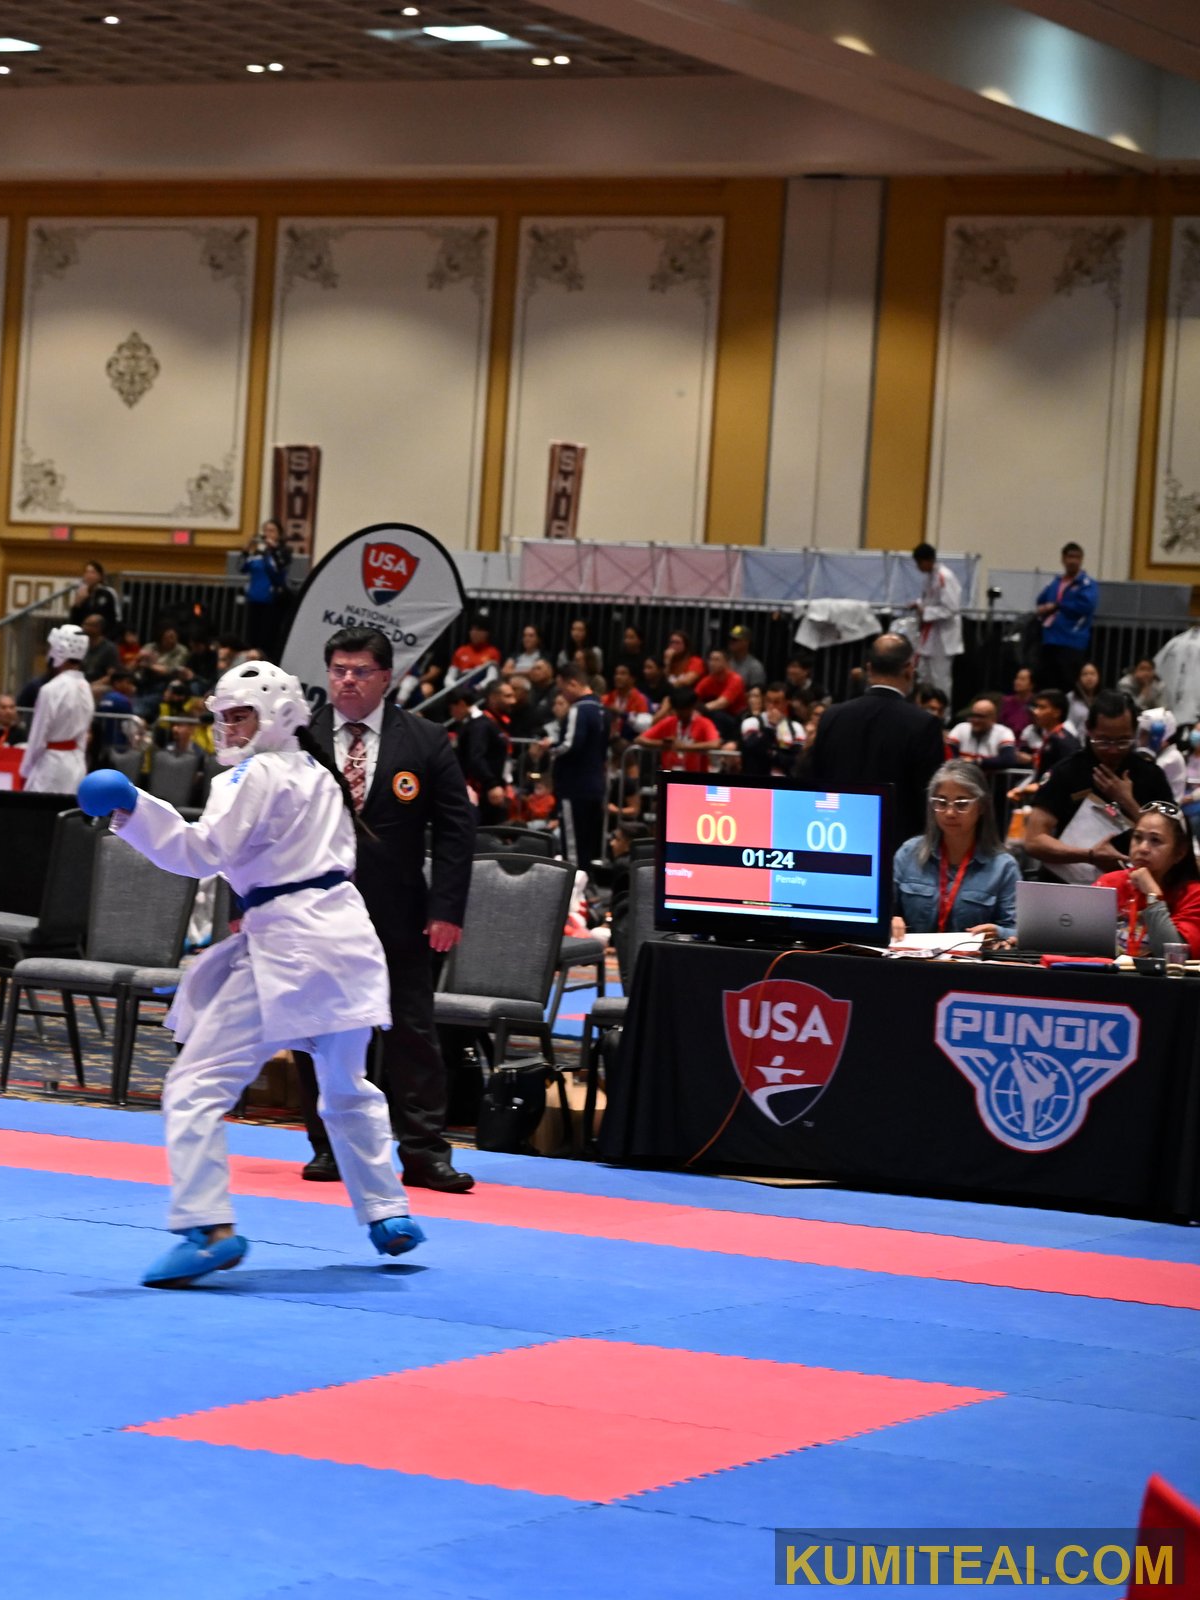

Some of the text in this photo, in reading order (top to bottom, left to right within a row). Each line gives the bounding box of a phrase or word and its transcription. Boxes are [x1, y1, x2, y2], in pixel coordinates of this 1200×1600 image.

[368, 549, 408, 576] USA
[344, 605, 401, 627] NATIONAL
[696, 813, 737, 845] 00
[806, 821, 847, 852] 00
[741, 848, 796, 869] 01:24
[775, 874, 807, 886] Penalty
[738, 998, 833, 1045] USA
